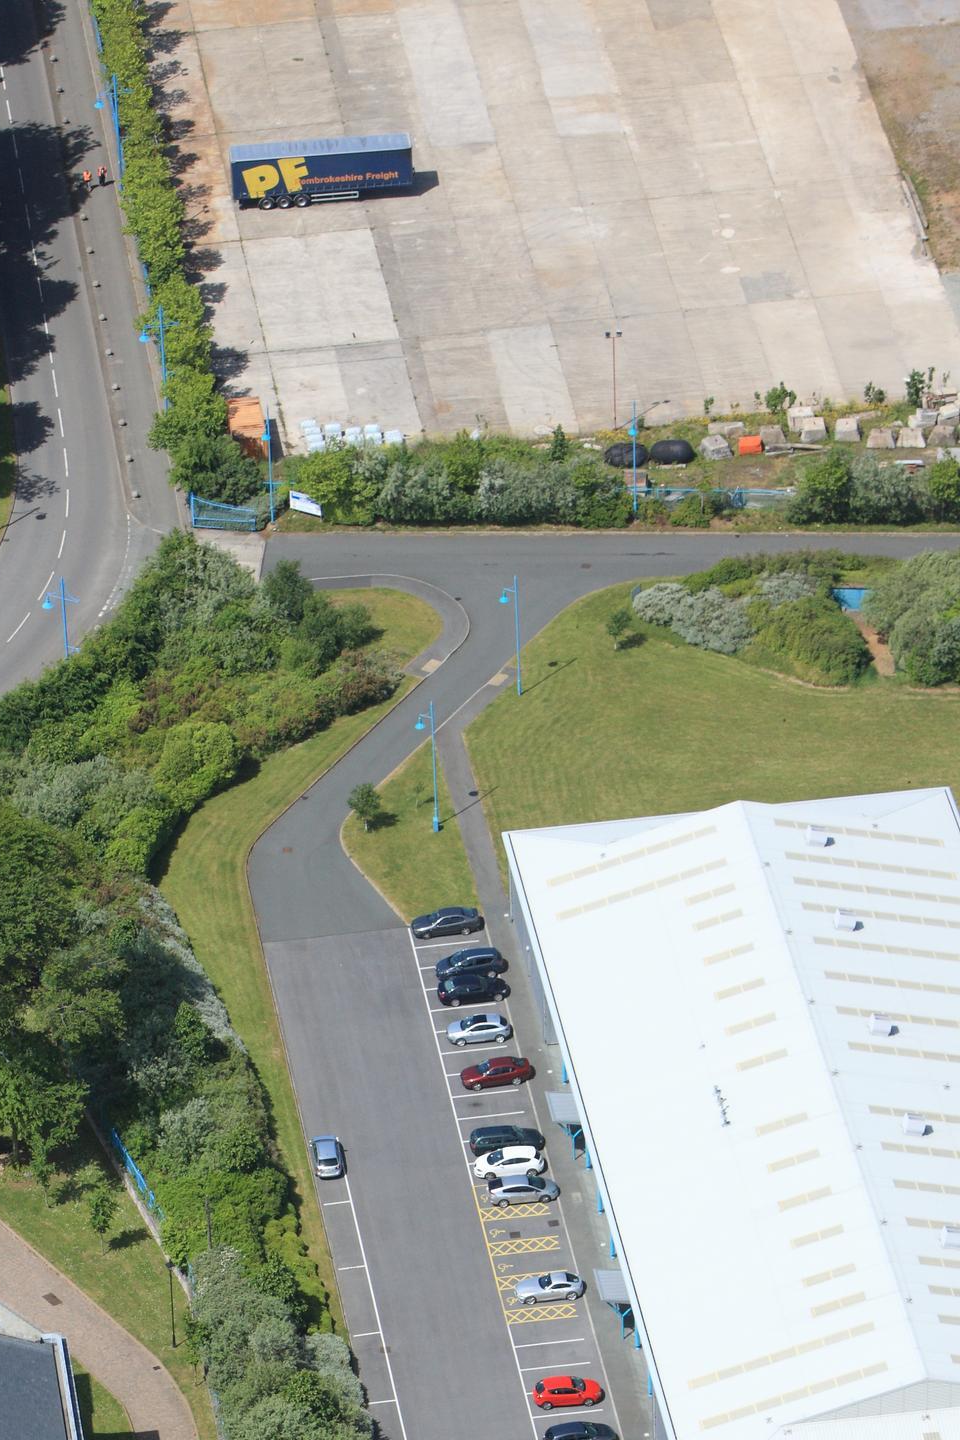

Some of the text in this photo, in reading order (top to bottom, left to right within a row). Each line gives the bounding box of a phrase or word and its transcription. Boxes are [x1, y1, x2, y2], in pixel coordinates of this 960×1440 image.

[242, 157, 309, 199] PF
[295, 171, 399, 186] embrokeshire Freight
